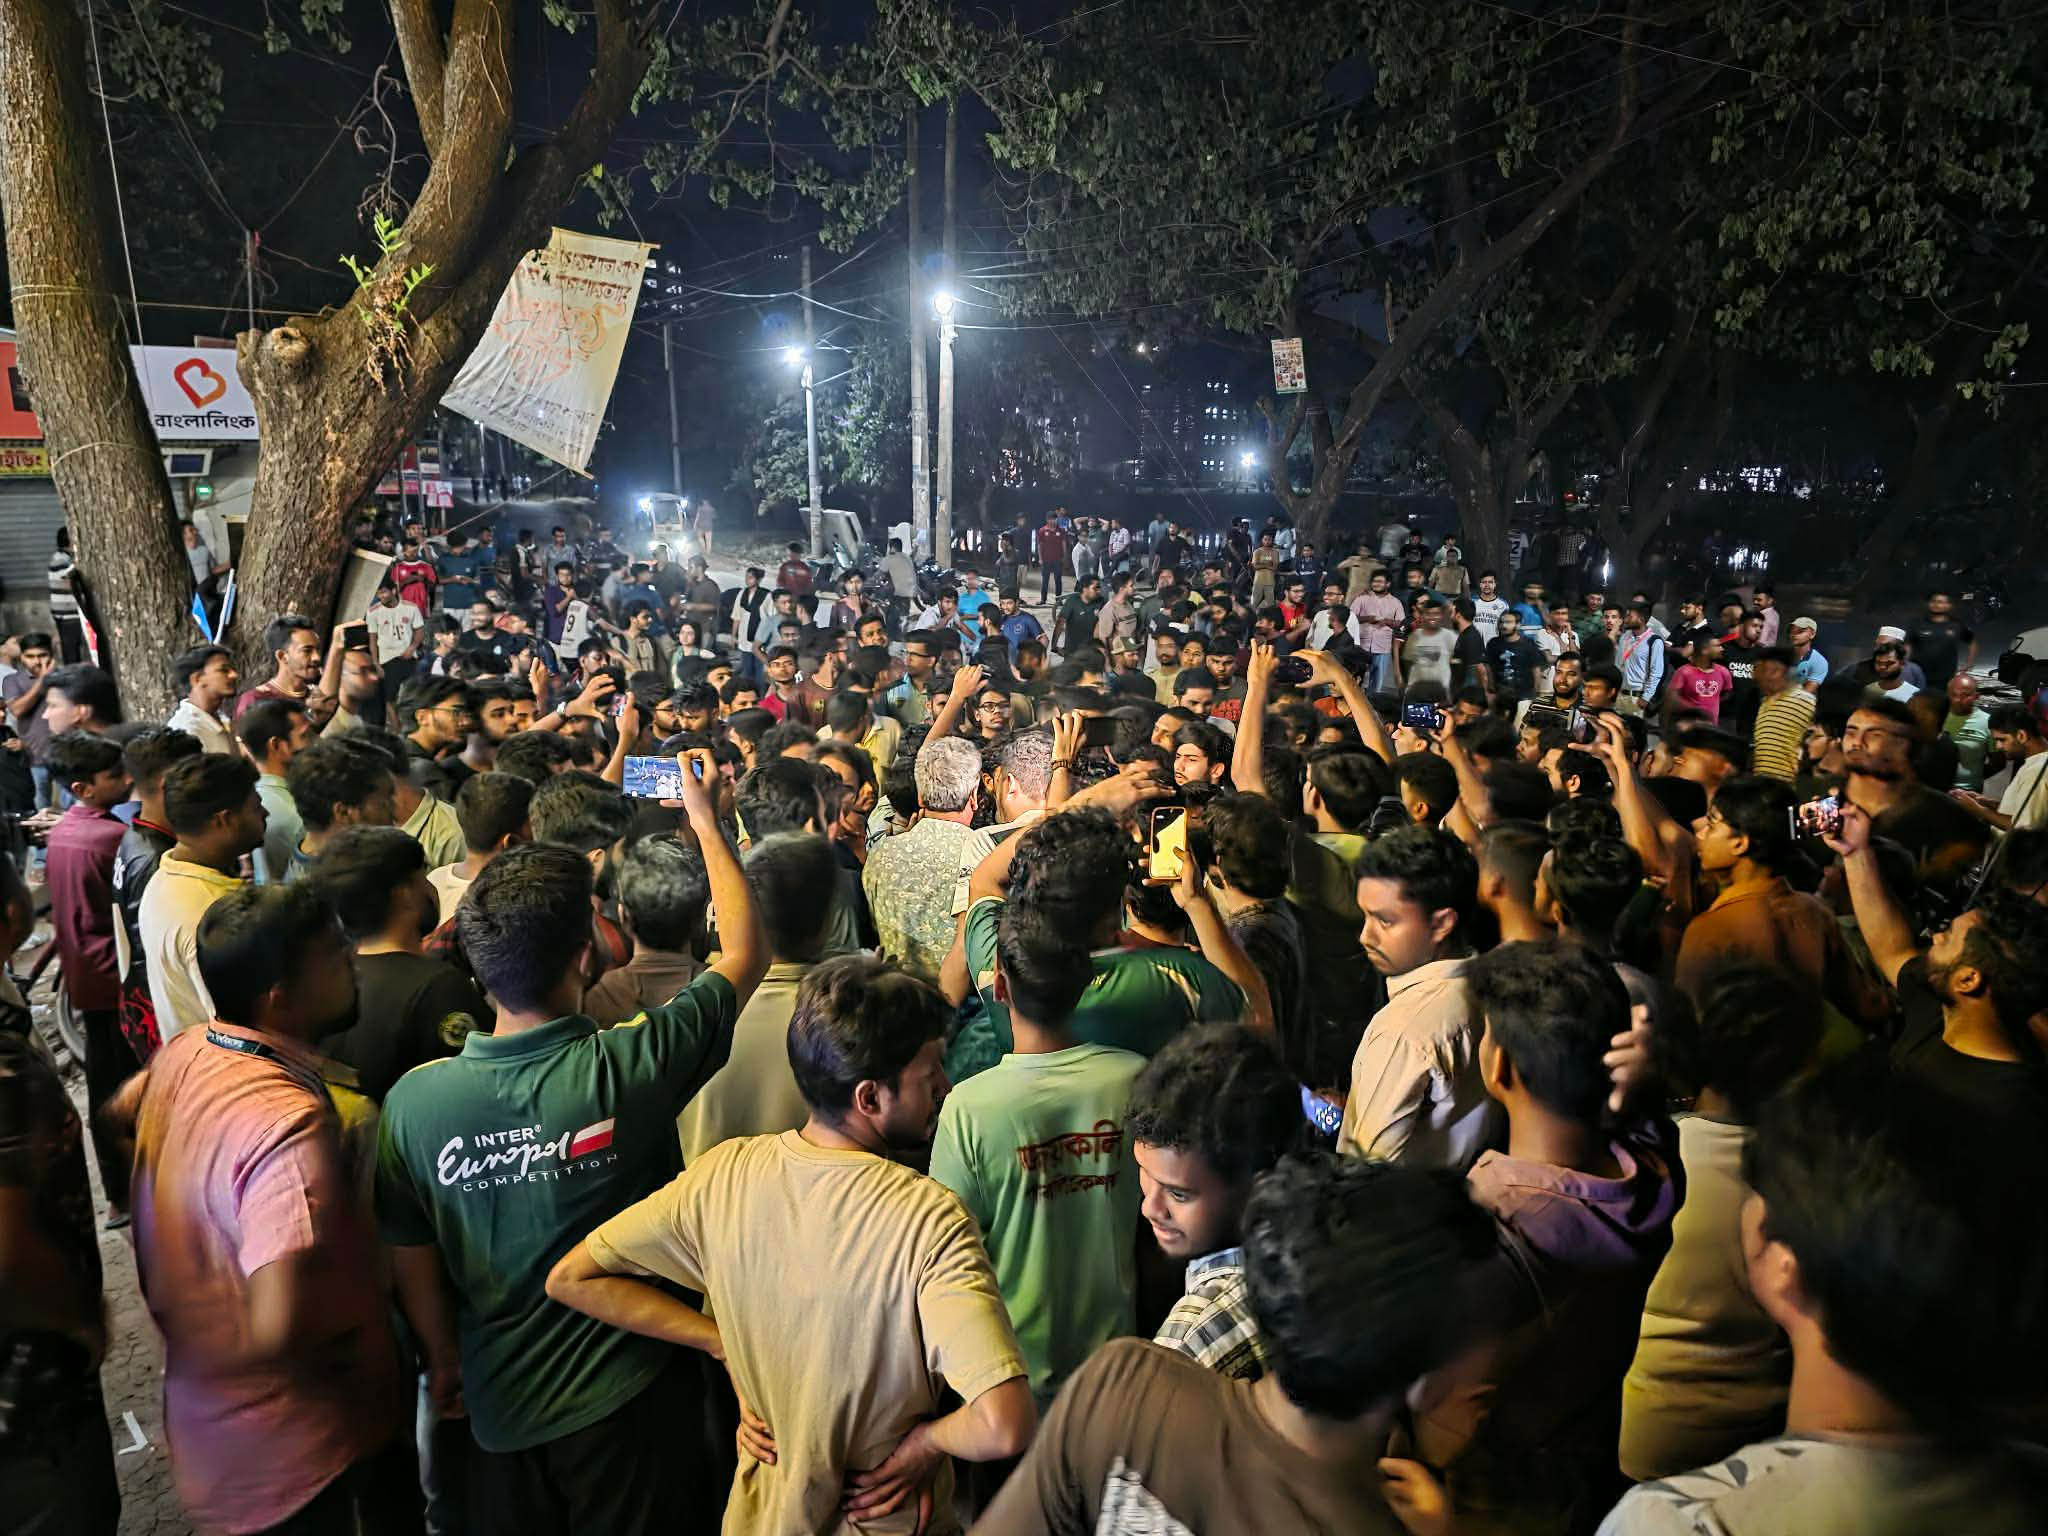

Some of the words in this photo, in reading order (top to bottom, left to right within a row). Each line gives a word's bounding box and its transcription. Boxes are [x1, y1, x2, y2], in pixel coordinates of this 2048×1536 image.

[155, 411, 256, 429] বাংলালিংক
[567, 614, 576, 632] 9
[437, 1131, 571, 1186] Europol
[462, 1153, 617, 1192] COMPETITION
